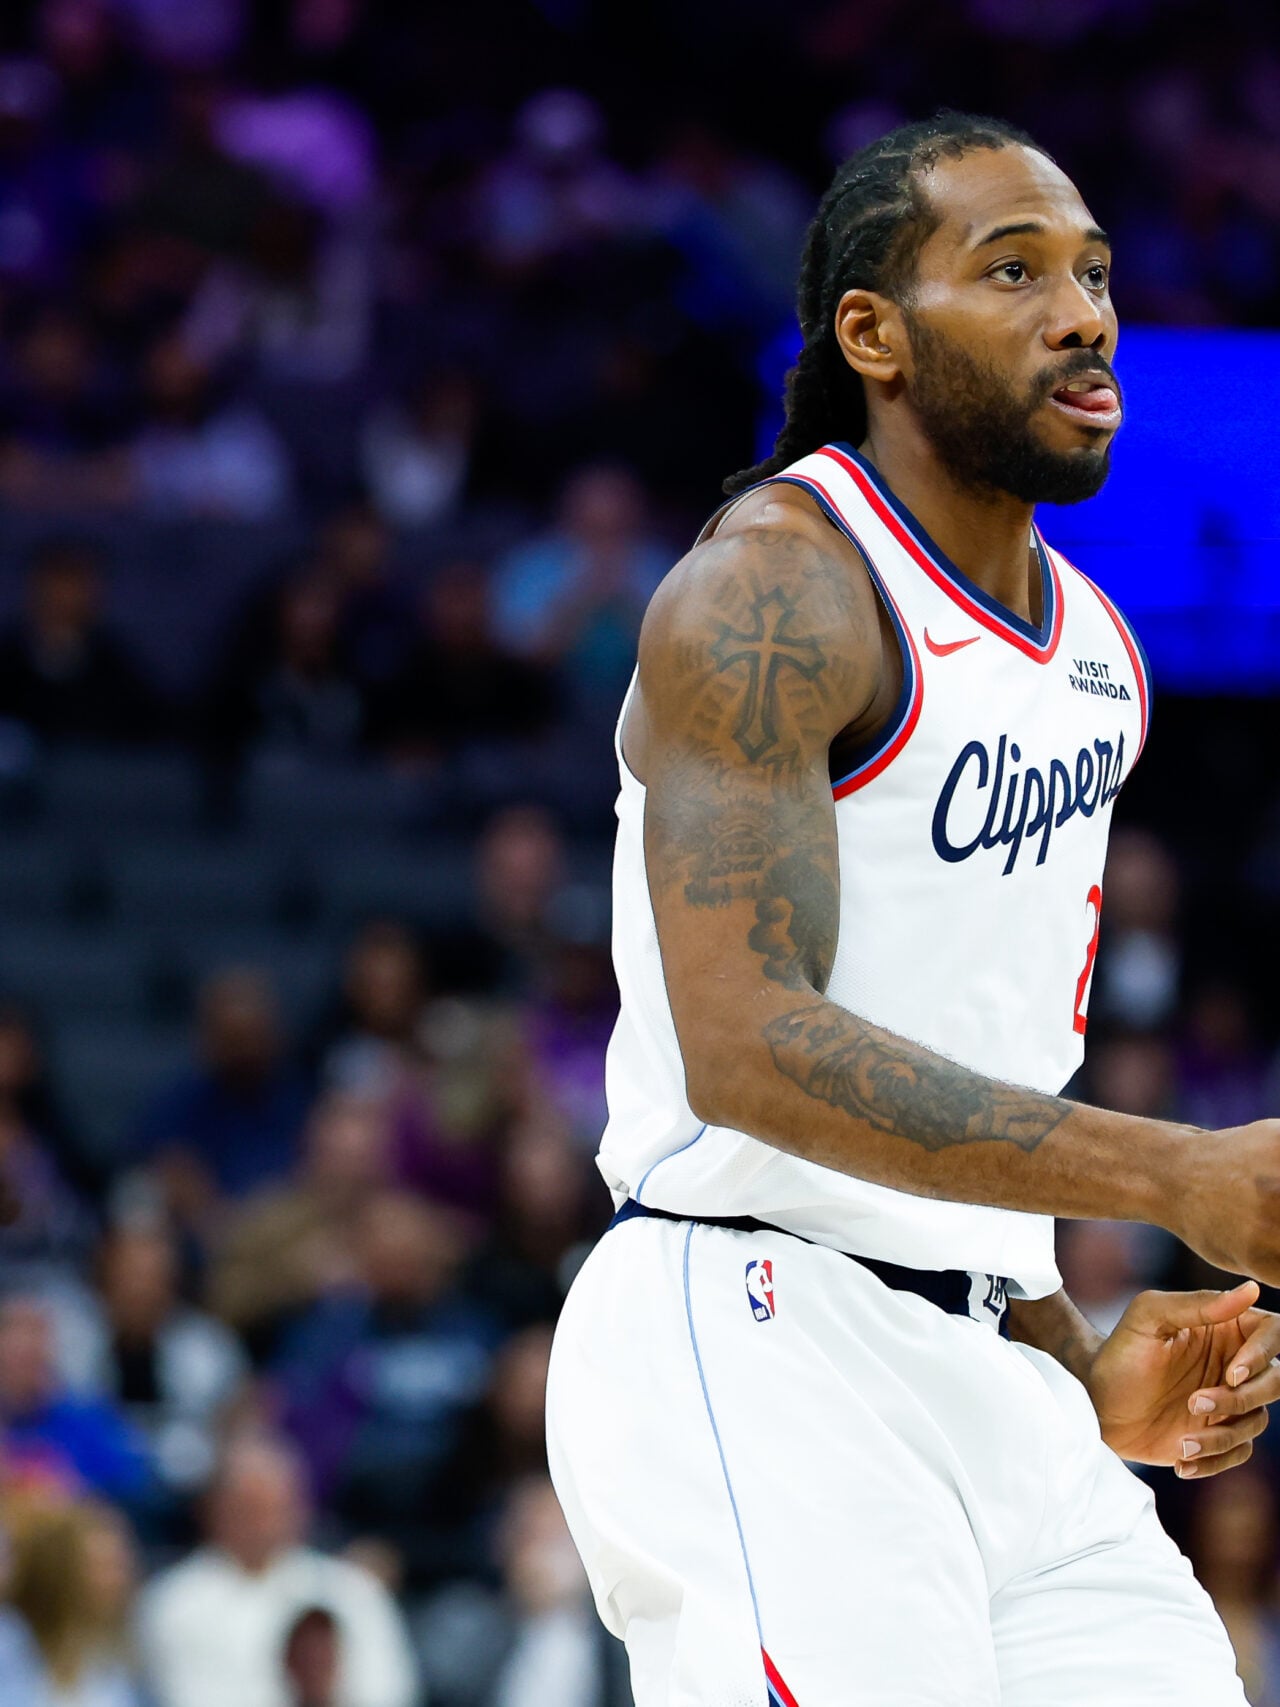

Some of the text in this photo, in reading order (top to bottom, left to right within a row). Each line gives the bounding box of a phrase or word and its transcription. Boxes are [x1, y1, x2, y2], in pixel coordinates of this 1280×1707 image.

[1072, 658, 1109, 680] VISIT
[1068, 673, 1131, 701] RWANDA
[931, 730, 1125, 877] Clippers
